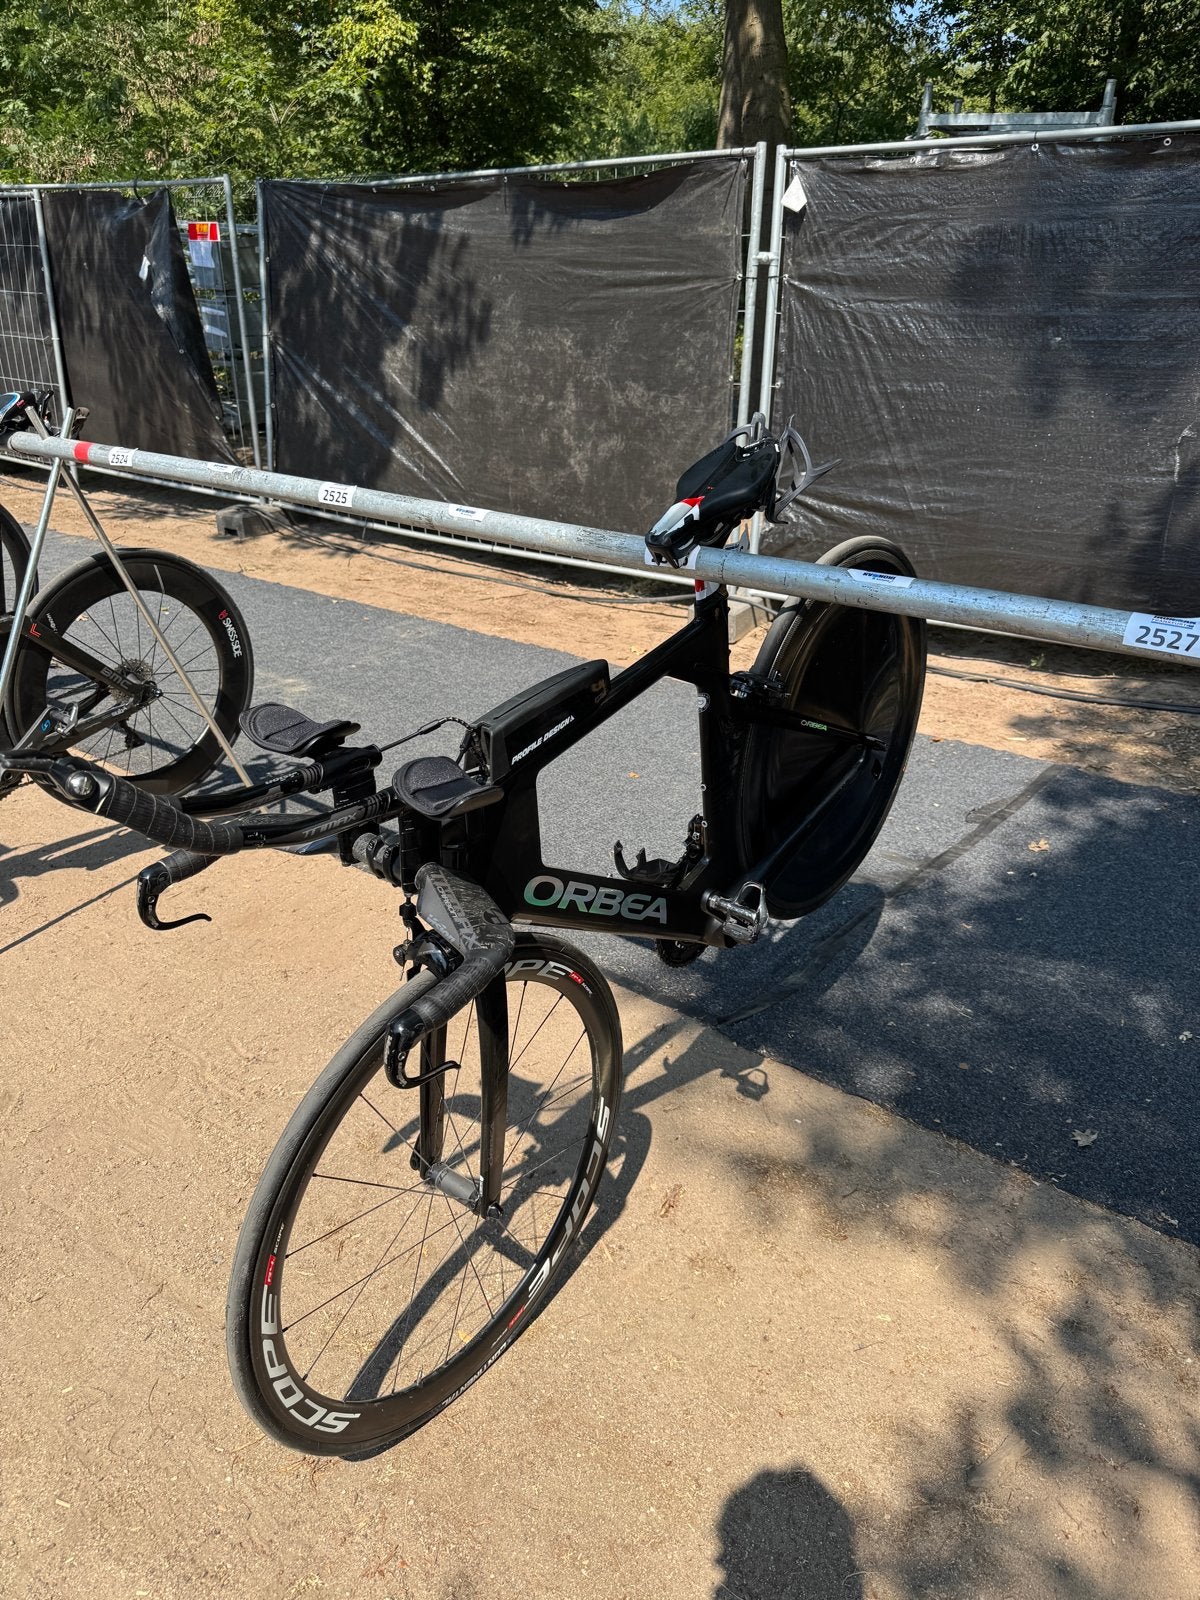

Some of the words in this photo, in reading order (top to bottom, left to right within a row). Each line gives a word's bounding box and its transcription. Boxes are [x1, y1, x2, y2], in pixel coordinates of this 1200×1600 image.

[110, 453, 129, 465] 2524
[323, 489, 348, 504] 2525
[1135, 625, 1200, 652] 2527
[100, 666, 132, 690] BMC
[511, 736, 543, 766] PROFILE
[542, 716, 571, 742] DESIGN
[800, 719, 828, 732] ORBEA
[523, 875, 668, 925] ORBEA
[523, 1096, 611, 1310] SCOPE
[261, 1284, 361, 1434] SCOPE
[441, 1341, 507, 1406] CONTINENTAL
